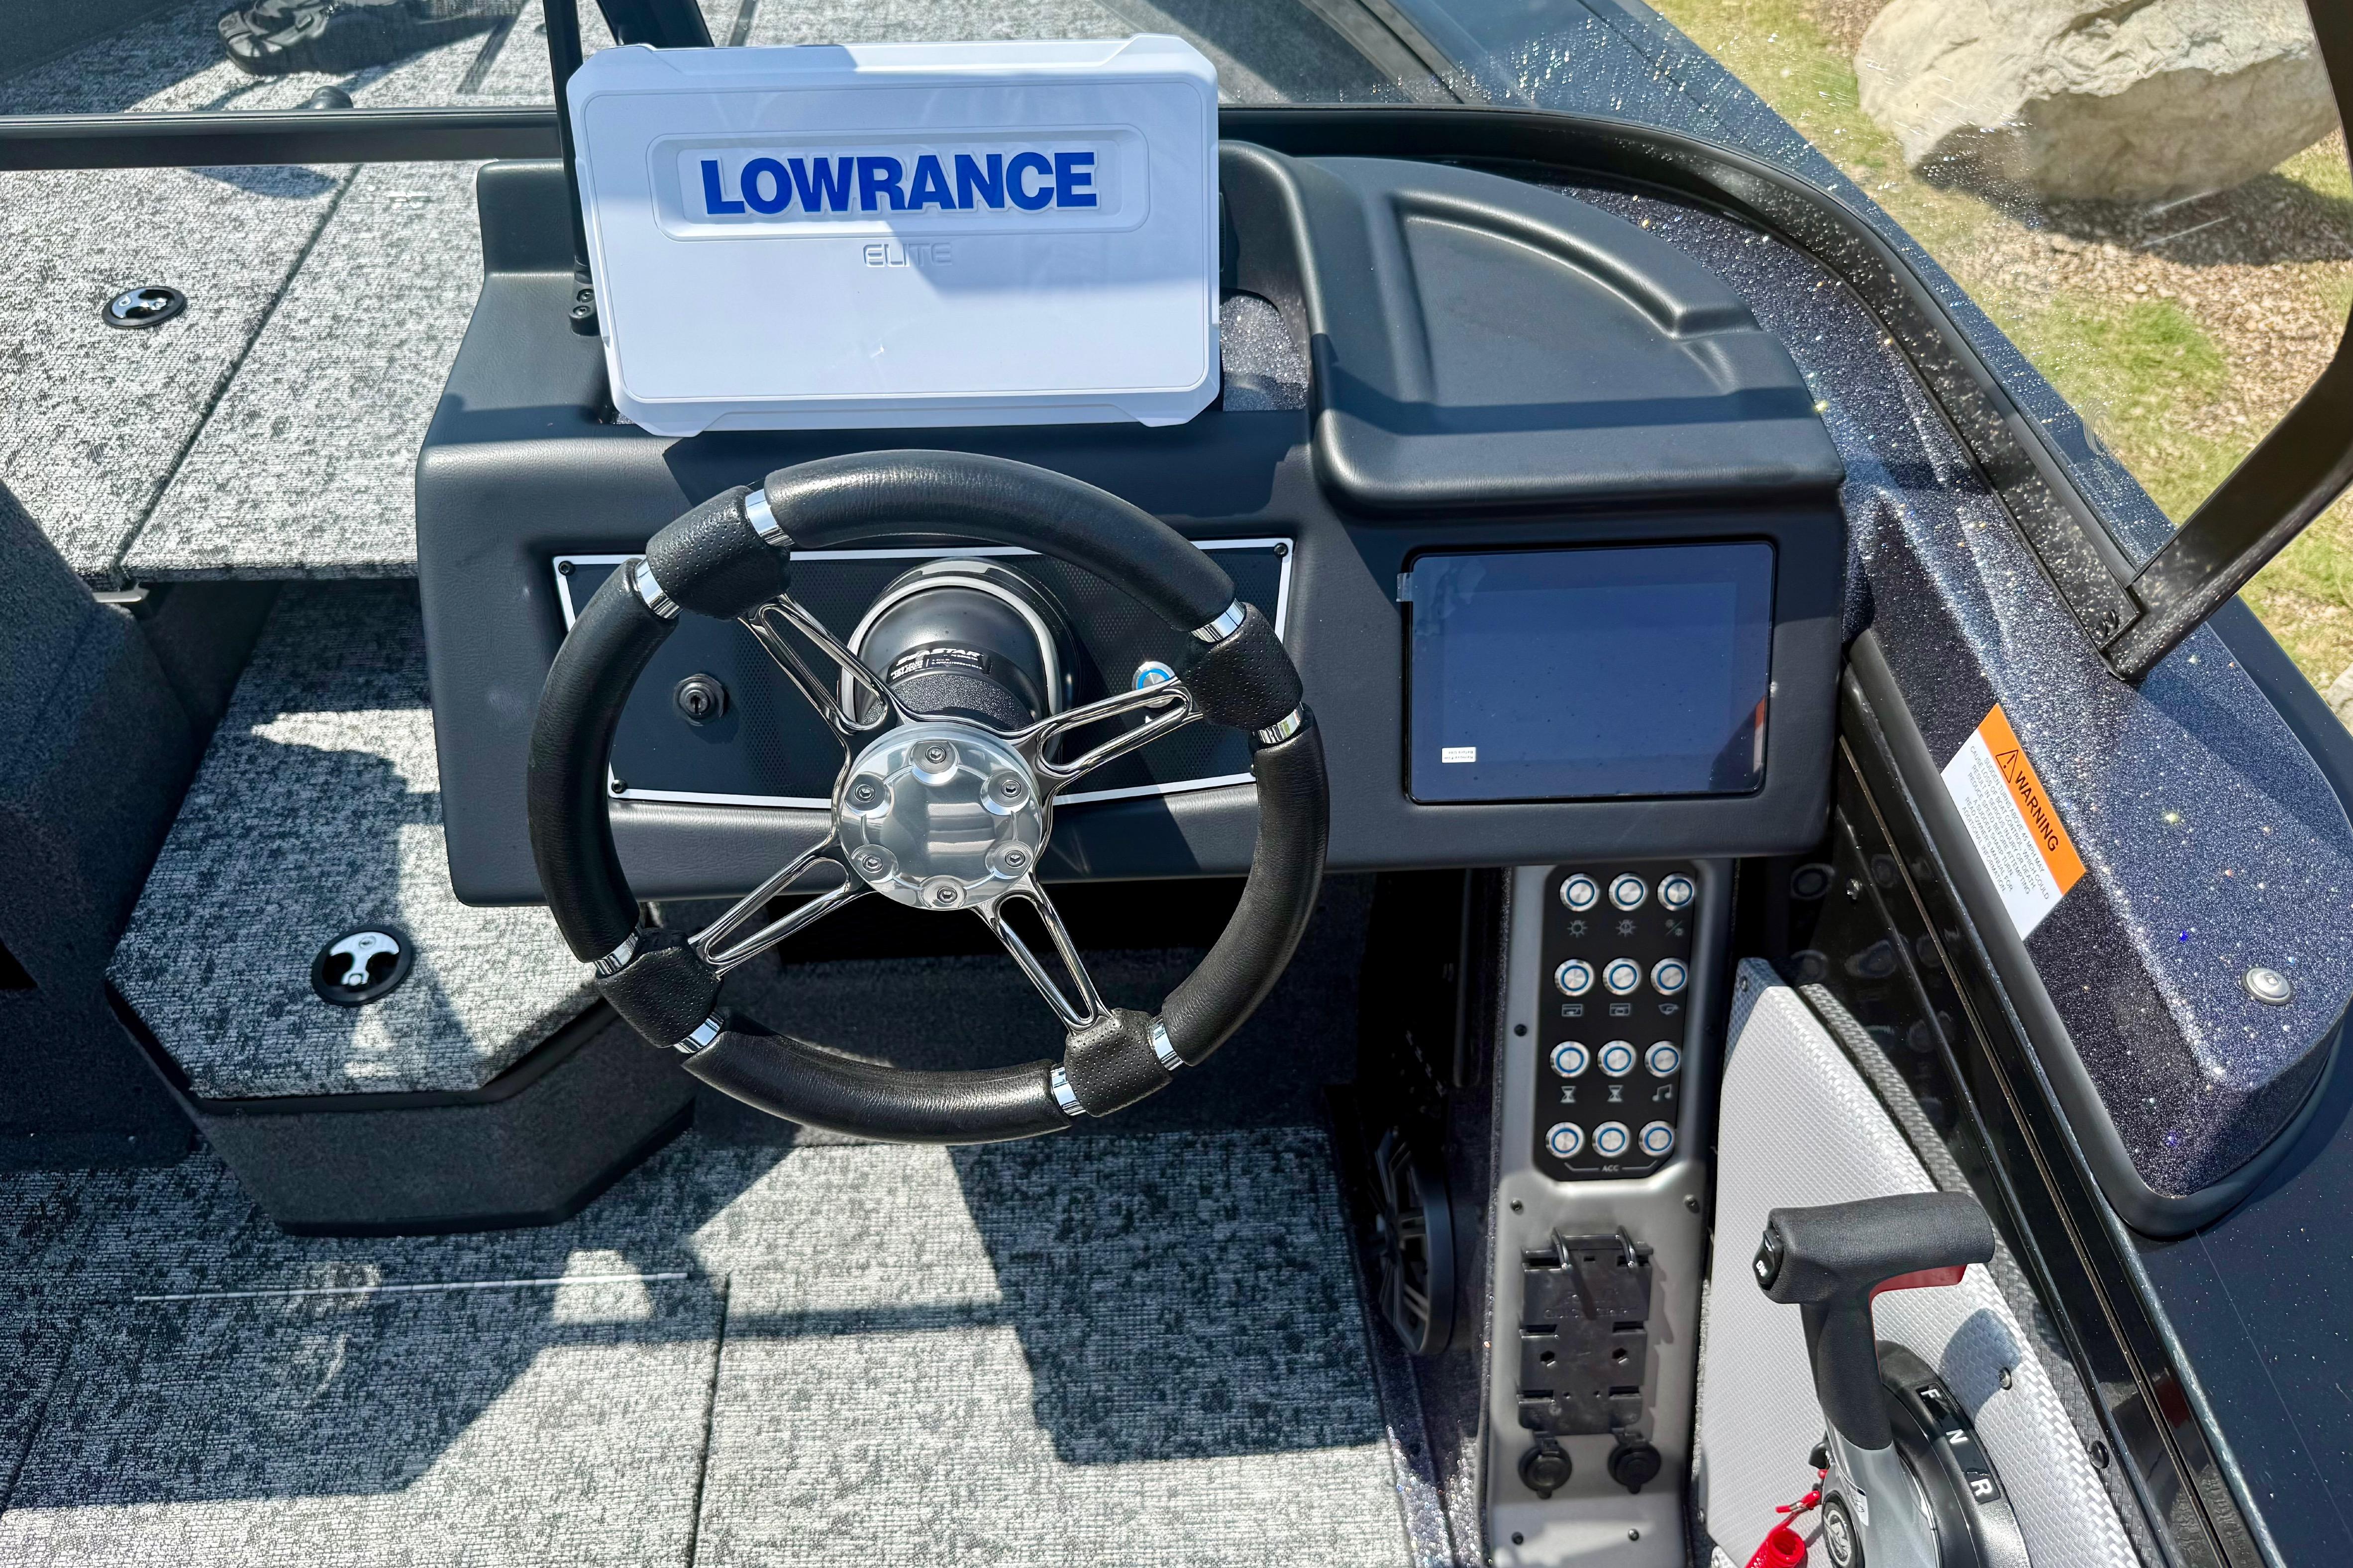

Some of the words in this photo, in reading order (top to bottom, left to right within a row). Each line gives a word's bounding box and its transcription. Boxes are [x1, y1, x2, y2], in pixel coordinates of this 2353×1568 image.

[701, 152, 1097, 214] LOWRANCE
[863, 242, 952, 268] ELITE
[1971, 764, 1986, 791] RESULT
[1984, 788, 1990, 799] IN
[1988, 797, 2005, 829] SERIOUS
[2003, 826, 2018, 854] INJURY
[2015, 851, 2024, 865] OR
[1973, 797, 1978, 806] A
[1975, 803, 1992, 833] SUDDEN
[1983, 757, 2000, 786] SUDDEN
[1998, 786, 2012, 809] TURNS
[2009, 807, 2024, 833] ABOVE
[2021, 830, 2028, 841] 45
[2026, 840, 2037, 858] MPH
[2034, 856, 2045, 874] MAY
[2015, 771, 2058, 852] WARNING
[1961, 805, 1983, 846] ADDITIONAL
[1967, 772, 1983, 801] REDUCE
[1981, 799, 1995, 824] SPEED
[1992, 821, 2009, 851] BEFORE
[2006, 849, 2031, 895] ATTEMPTING
[1969, 745, 1983, 769] CAUSE
[1981, 767, 1992, 787] LOSS
[1990, 785, 1997, 797] OF
[1995, 795, 2007, 816] BOAT
[2022, 848, 2037, 875] WHICH
[2034, 873, 2049, 900] COULD
[1964, 796, 1976, 817] READ
[1973, 815, 1991, 848] OWNER'S
[1989, 846, 2006, 876] MANUAL
[2003, 875, 2013, 892] FOR
[1989, 831, 2004, 857] SHARP
[1920, 1388, 1941, 1398] F
[1946, 1429, 1968, 1444] N
[1971, 1478, 1993, 1496] R
